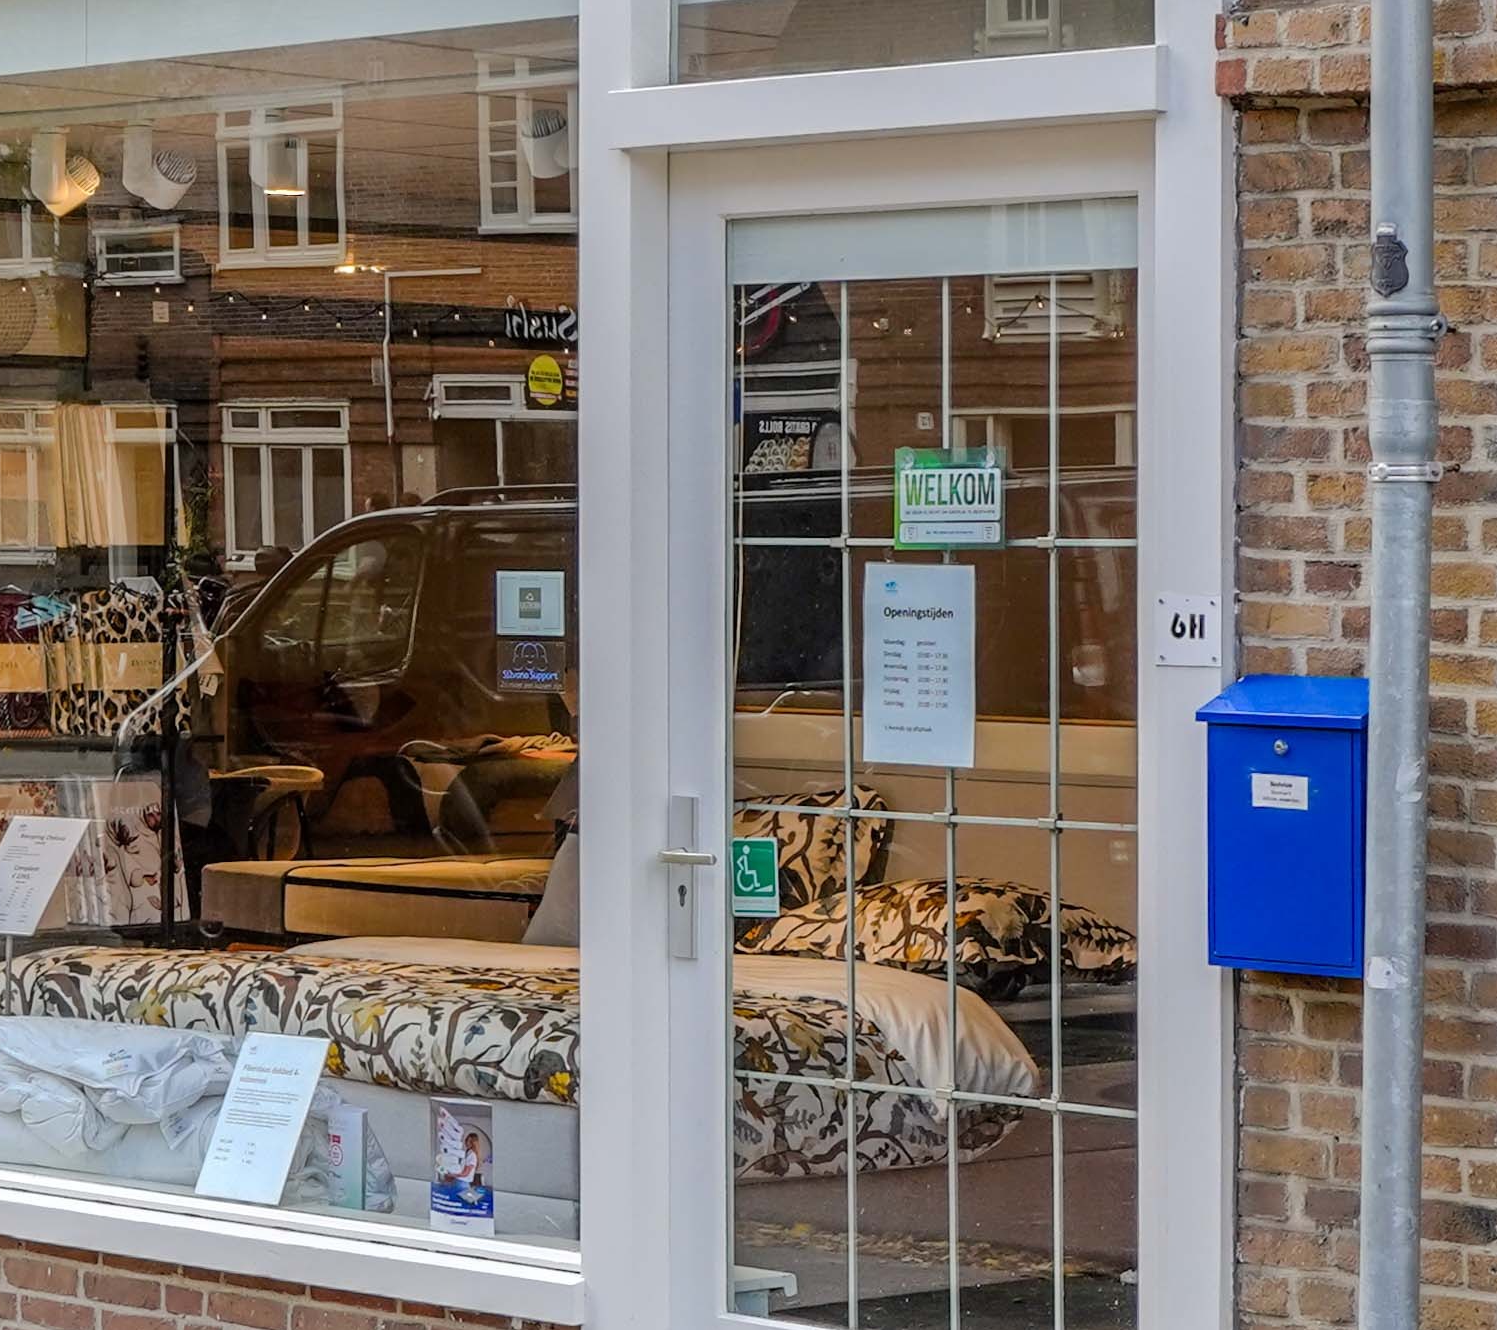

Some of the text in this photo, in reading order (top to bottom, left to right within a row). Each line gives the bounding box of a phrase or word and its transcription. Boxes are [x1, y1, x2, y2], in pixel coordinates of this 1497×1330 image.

[905, 473, 995, 506] WELKOM
[883, 606, 954, 620] Openingstijden
[1170, 612, 1207, 640] 6H
